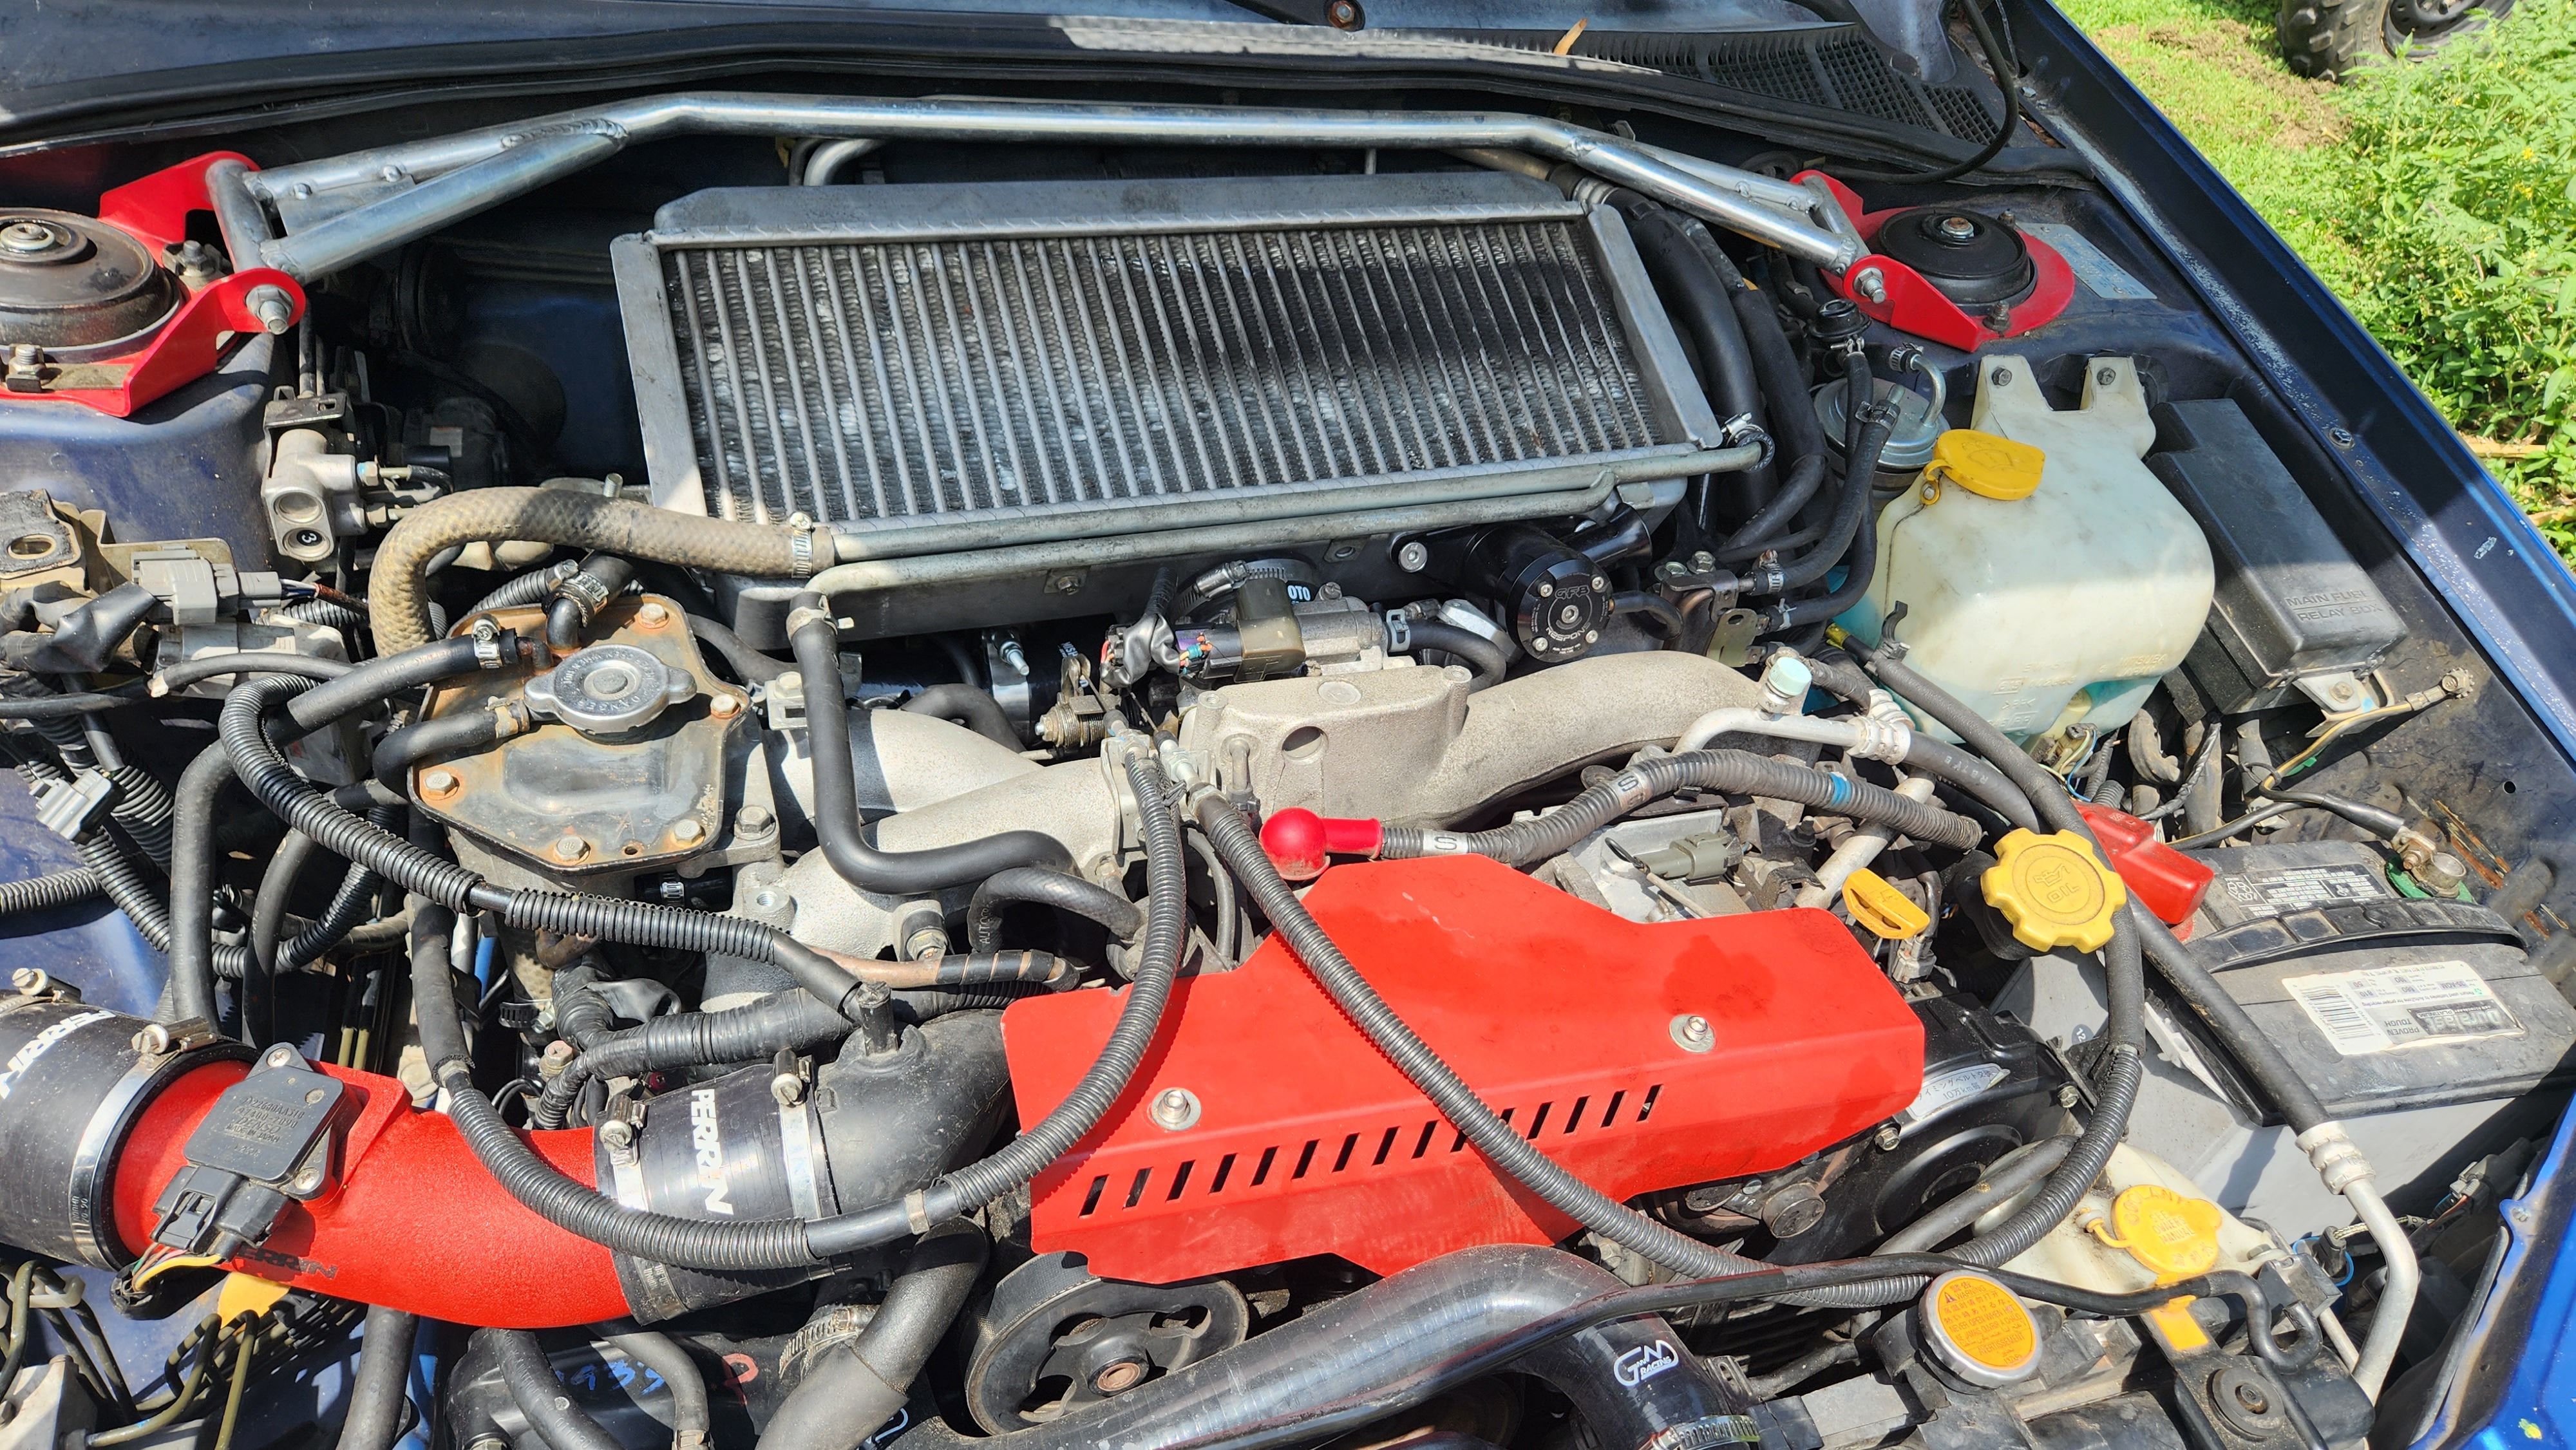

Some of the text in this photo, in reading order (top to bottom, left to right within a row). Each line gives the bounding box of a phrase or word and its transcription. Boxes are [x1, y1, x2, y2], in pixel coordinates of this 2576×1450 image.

[1555, 585, 1590, 599] GFB
[2285, 594, 2330, 607] MAIN
[2297, 603, 2384, 621] RELAY BOX
[1434, 836, 1457, 851] S
[2047, 882, 2080, 903] OIL
[2385, 1018, 2412, 1028] TOUGH
[2418, 1009, 2454, 1019] PLATINUM
[2426, 1008, 2501, 1032] Duralast
[2387, 1026, 2420, 1036] PROVEN
[235, 1116, 281, 1134] DENSO
[691, 1089, 734, 1215] PERRIN
[2152, 1214, 2187, 1235] OWNERS
[2158, 1226, 2195, 1247] MANUAL
[1956, 1284, 1987, 1300] WARNING
[1977, 1332, 2025, 1356] AVERTISSEMENT
[1640, 1355, 1672, 1376] RACING
